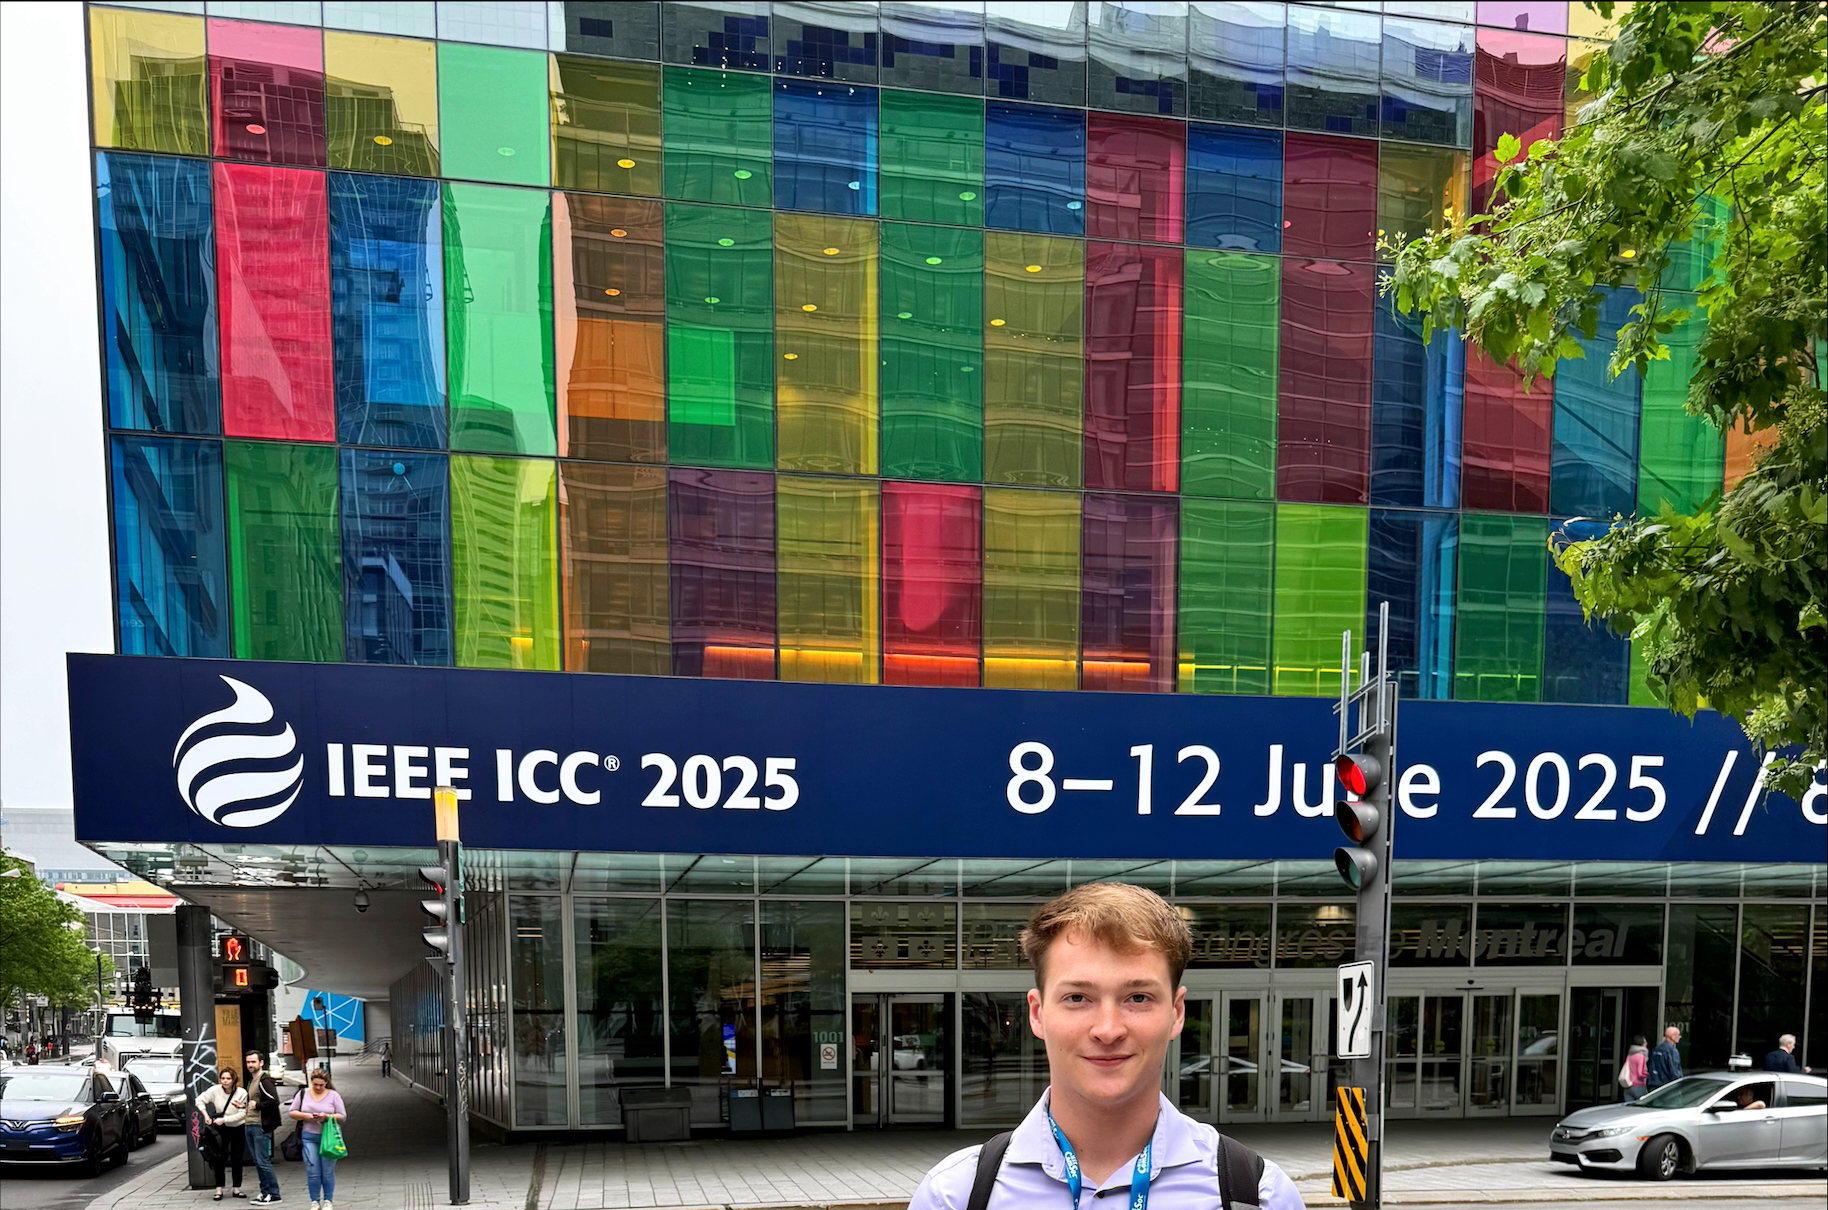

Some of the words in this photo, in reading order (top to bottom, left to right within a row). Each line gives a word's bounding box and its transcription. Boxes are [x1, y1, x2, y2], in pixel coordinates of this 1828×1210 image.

[328, 744, 472, 805] IEEE
[642, 753, 799, 813] 2025
[1255, 745, 1441, 819] Jue
[1473, 751, 1666, 822] 2025
[812, 1031, 844, 1043] 1001
